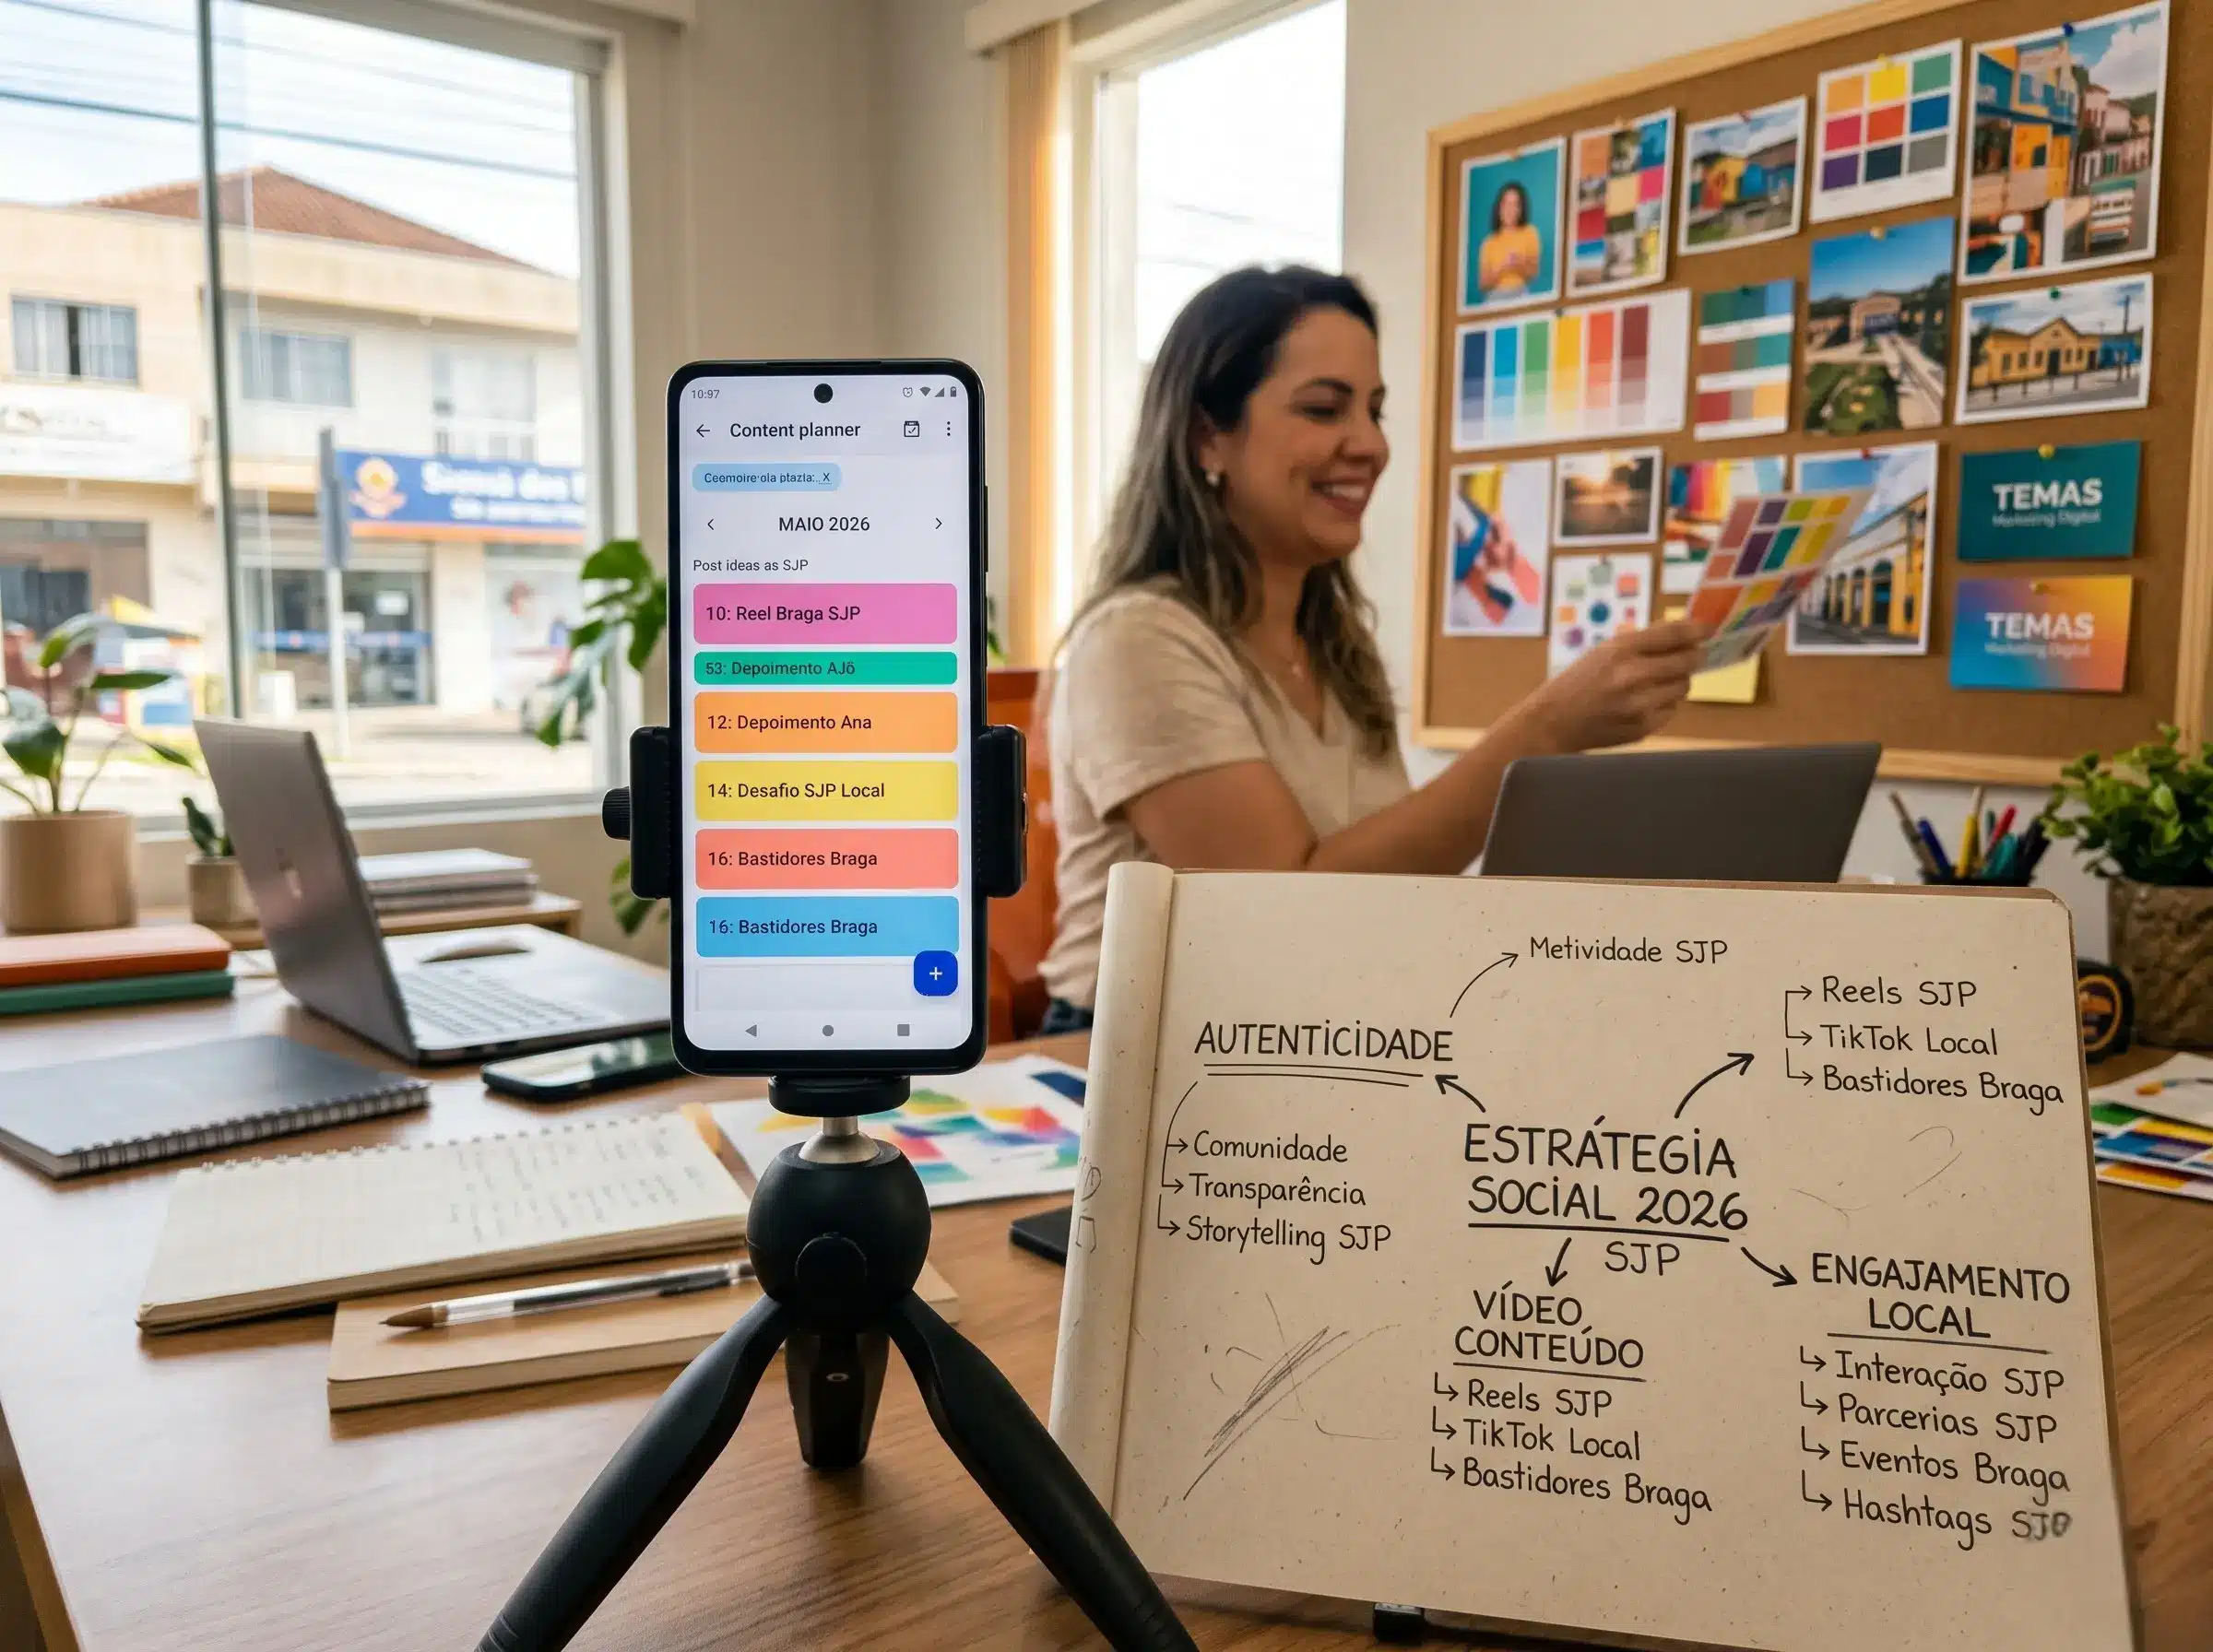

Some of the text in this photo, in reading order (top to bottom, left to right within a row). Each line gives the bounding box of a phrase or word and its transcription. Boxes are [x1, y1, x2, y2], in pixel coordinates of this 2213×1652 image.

[691, 389, 720, 399] 10:97
[729, 421, 861, 441] Content planner
[1992, 477, 2103, 510] TEMAS
[778, 516, 870, 532] MAIO 2026
[692, 559, 809, 572] Post ideas as SJP
[705, 605, 861, 625] 10: Reel Braga SJP
[1984, 612, 2096, 640] TEMAS
[705, 662, 727, 675] 53:
[731, 661, 822, 678] Depoimento
[707, 714, 872, 733] 12: Depoimento Ana
[707, 782, 885, 798] 14: Desafio SJP Local
[708, 850, 878, 870] 16: Bastidores Braga
[709, 918, 878, 938] 16: Bastidores Braga
[1530, 935, 1729, 966] Metividade SJP
[1822, 974, 1978, 1008] Reels SJP
[1818, 1023, 1998, 1056] TikTok Local
[1822, 1064, 2065, 1117] Bastidores Braga
[1193, 1130, 1349, 1163] Comunidade
[1188, 1172, 1367, 1210] Transparência
[1467, 1176, 1748, 1231] SOCIAL 2026
[1186, 1214, 1391, 1266] Storytelling SJP
[1604, 1240, 1681, 1277] SJP
[1812, 1252, 2070, 1304] ENGAJAMENTO
[1473, 1280, 1584, 1327] VÍDEO
[1868, 1297, 1992, 1339] LOCAL
[1453, 1326, 1644, 1369] CONTEÚDO
[1834, 1350, 2065, 1399] Interação SJP
[1468, 1377, 1613, 1419] Reels SJP
[1838, 1392, 2058, 1445] Parcerias SJP
[1462, 1418, 1640, 1461] TikTok Local
[1840, 1439, 2072, 1507] Eventos Braga
[1463, 1457, 1713, 1527] Bastidores Braga
[1843, 1487, 1993, 1552] Hashtags
